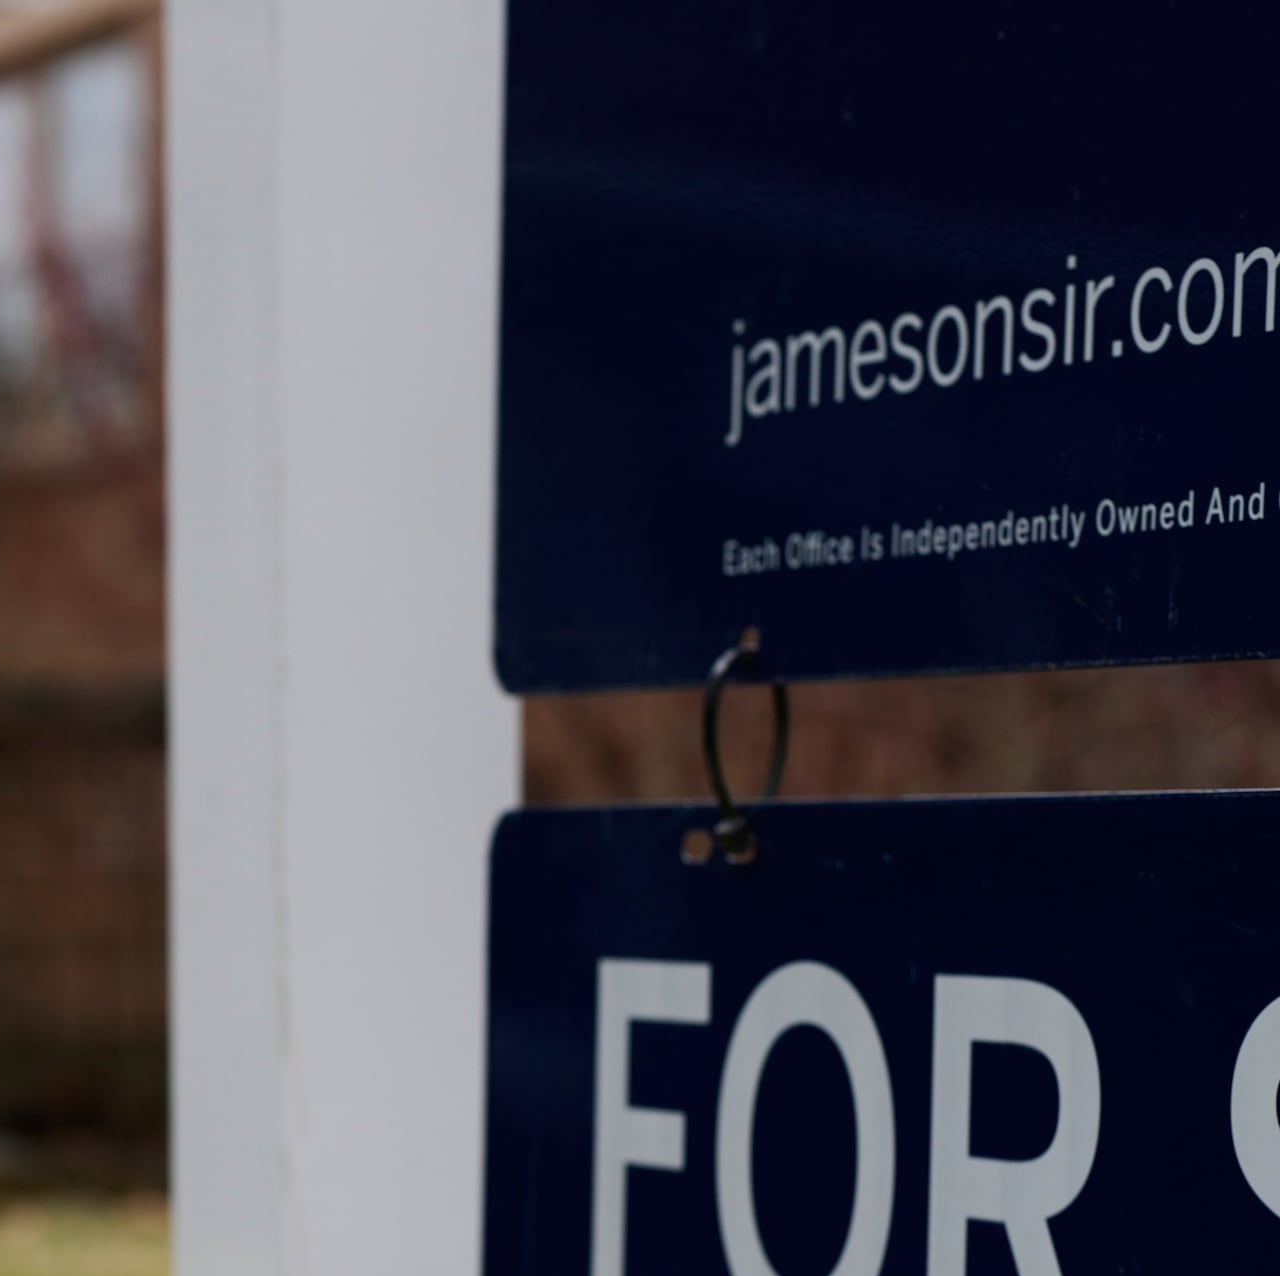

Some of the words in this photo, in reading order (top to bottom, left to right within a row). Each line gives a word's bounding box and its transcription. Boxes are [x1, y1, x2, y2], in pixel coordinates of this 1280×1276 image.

[723, 538, 780, 576] Each
[785, 530, 853, 567] Office
[860, 526, 884, 561] Is
[891, 505, 1085, 556] Independently
[1096, 490, 1195, 536] Owned
[1205, 482, 1265, 526] And
